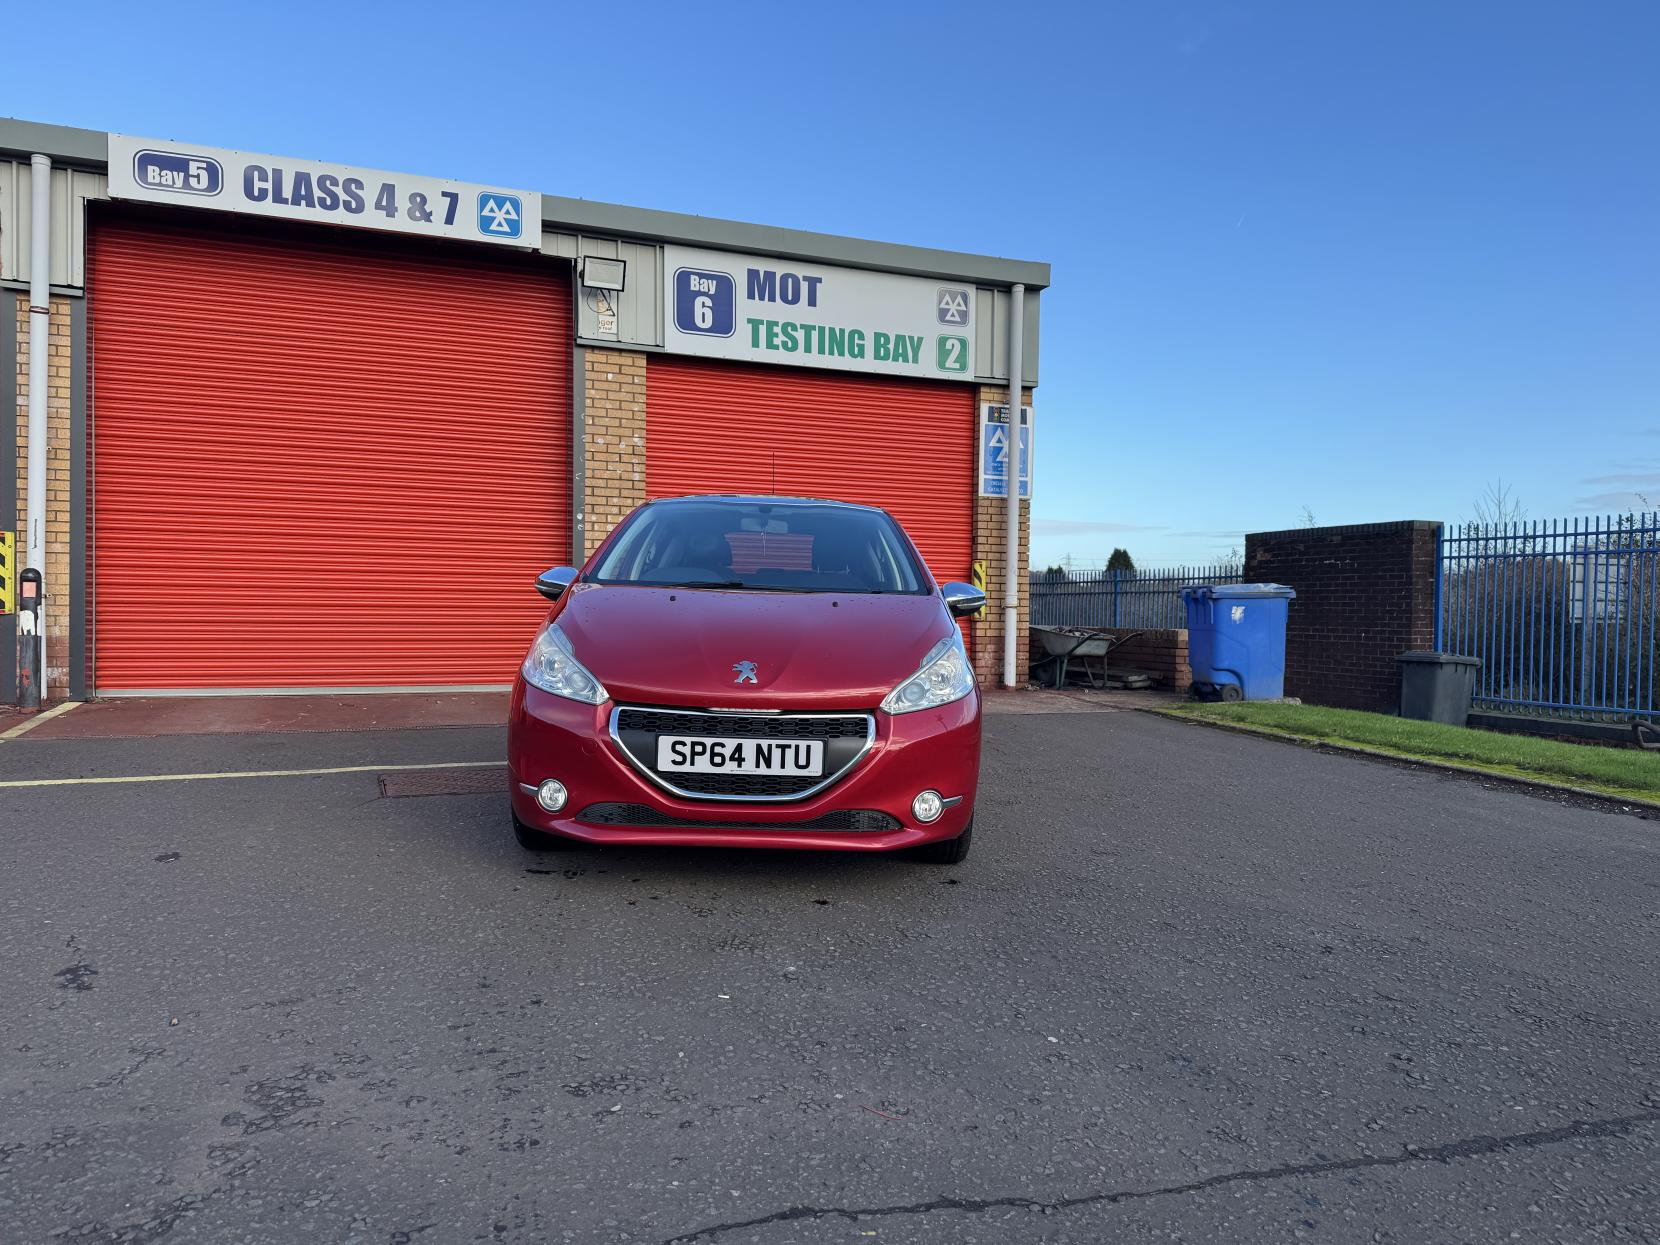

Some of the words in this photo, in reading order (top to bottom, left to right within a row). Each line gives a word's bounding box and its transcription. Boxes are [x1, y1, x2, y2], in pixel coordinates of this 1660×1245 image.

[147, 165, 184, 188] Bay
[188, 160, 209, 190] 5
[243, 164, 366, 215] CLASS
[374, 182, 398, 219] 4
[407, 191, 433, 223] &
[440, 190, 459, 226] 7
[690, 274, 717, 295] Bay
[746, 268, 823, 308] MOT
[694, 295, 713, 329] 6
[746, 317, 866, 360] TESTING
[873, 331, 925, 365] BAY
[944, 338, 961, 369] 2
[670, 740, 746, 769] SP64
[754, 743, 812, 770] NTU
